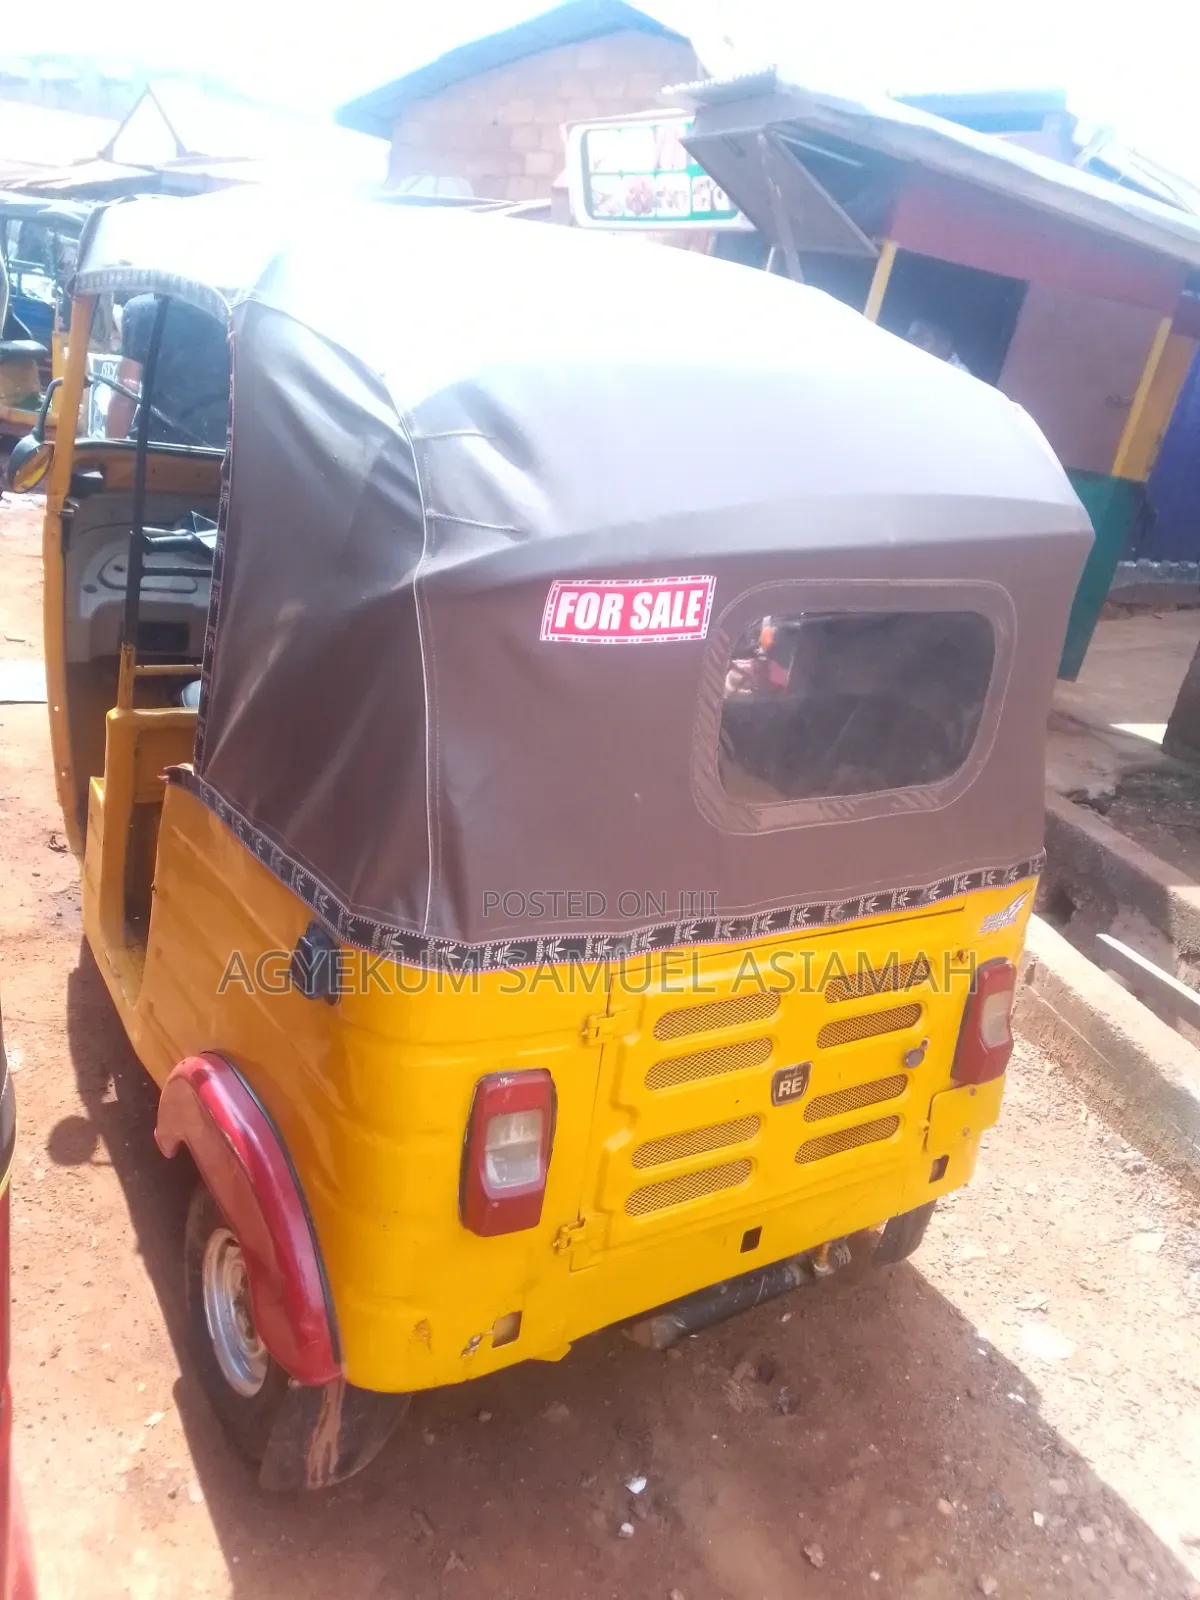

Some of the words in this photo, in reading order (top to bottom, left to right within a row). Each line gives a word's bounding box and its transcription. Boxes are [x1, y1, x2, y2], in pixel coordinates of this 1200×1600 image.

[554, 591, 625, 630] FOR
[629, 589, 704, 630] SALE
[777, 1075, 804, 1098] RE
